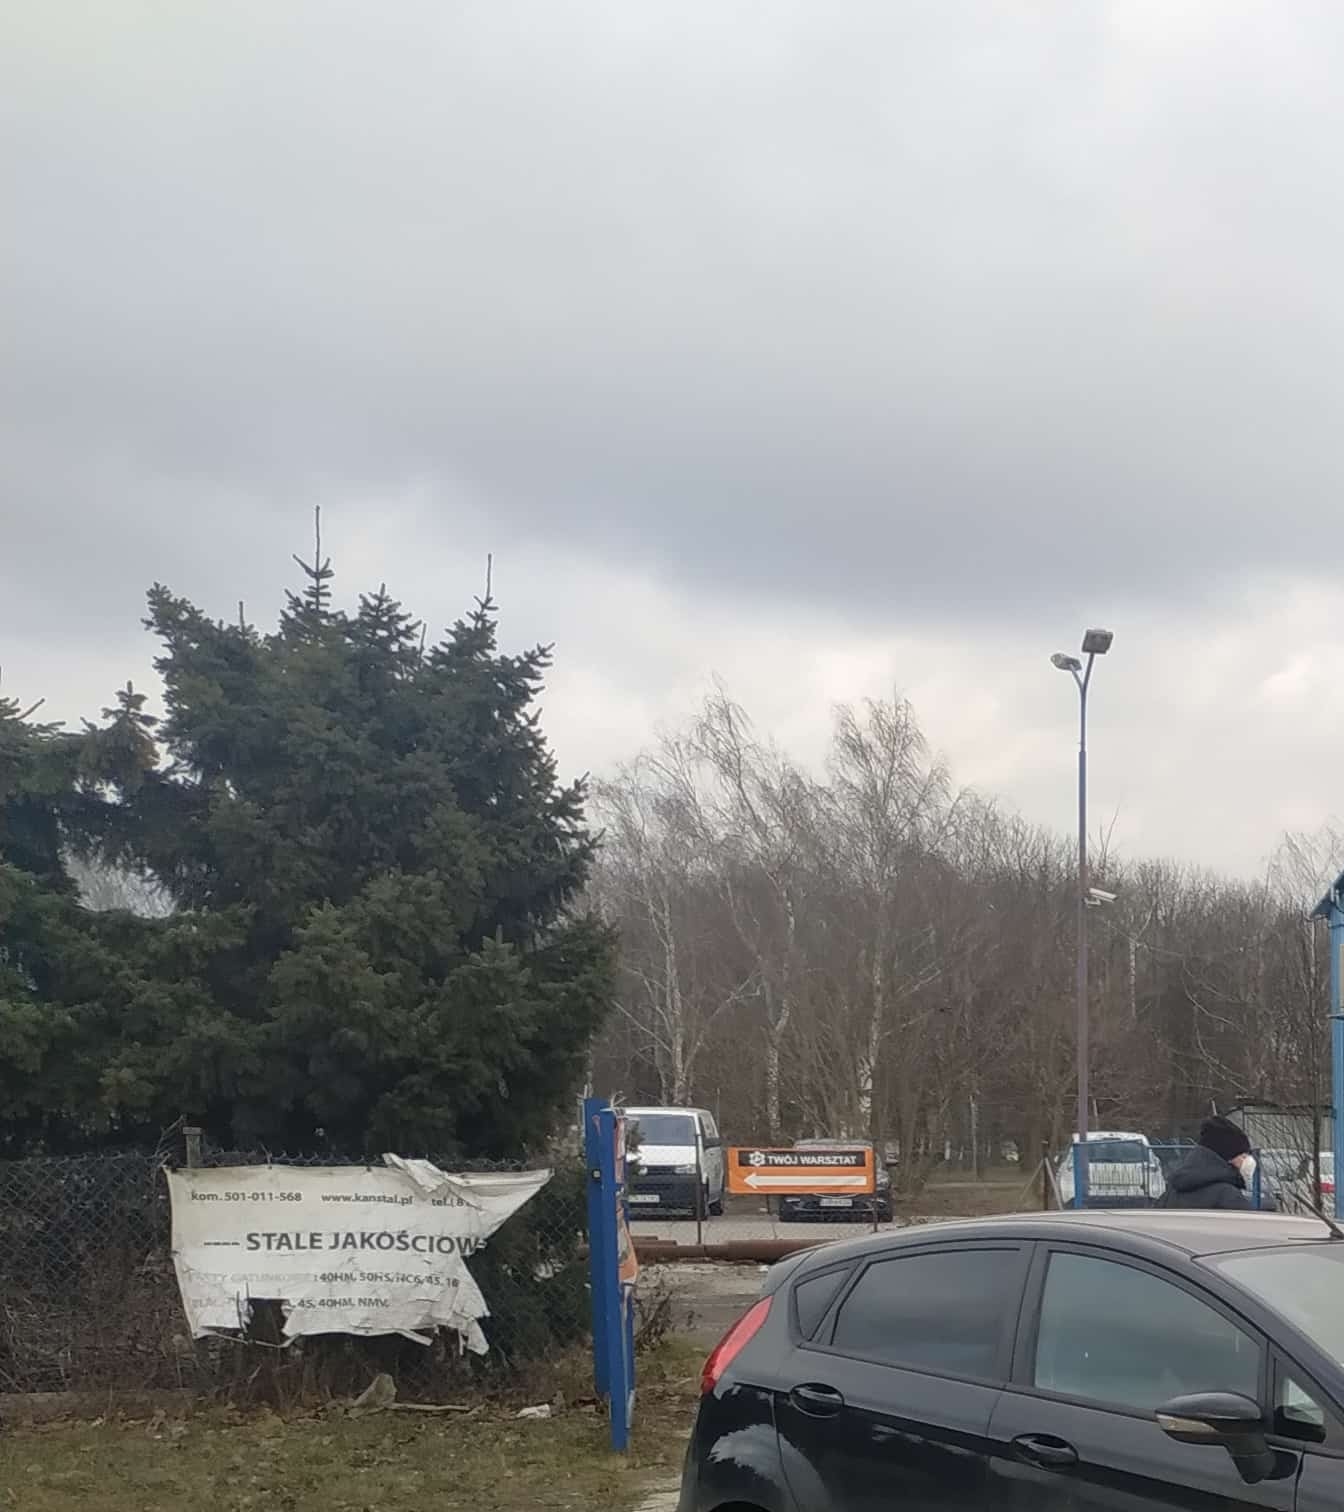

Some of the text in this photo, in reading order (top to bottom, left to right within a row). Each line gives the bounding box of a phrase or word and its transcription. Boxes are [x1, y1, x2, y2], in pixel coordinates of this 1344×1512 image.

[767, 1153, 857, 1165] TWÓJ WARSZTAT
[321, 1192, 414, 1207] www.kanstal.pl
[246, 1232, 323, 1251] STALE
[328, 1229, 487, 1255] JAKOŚCIOW
